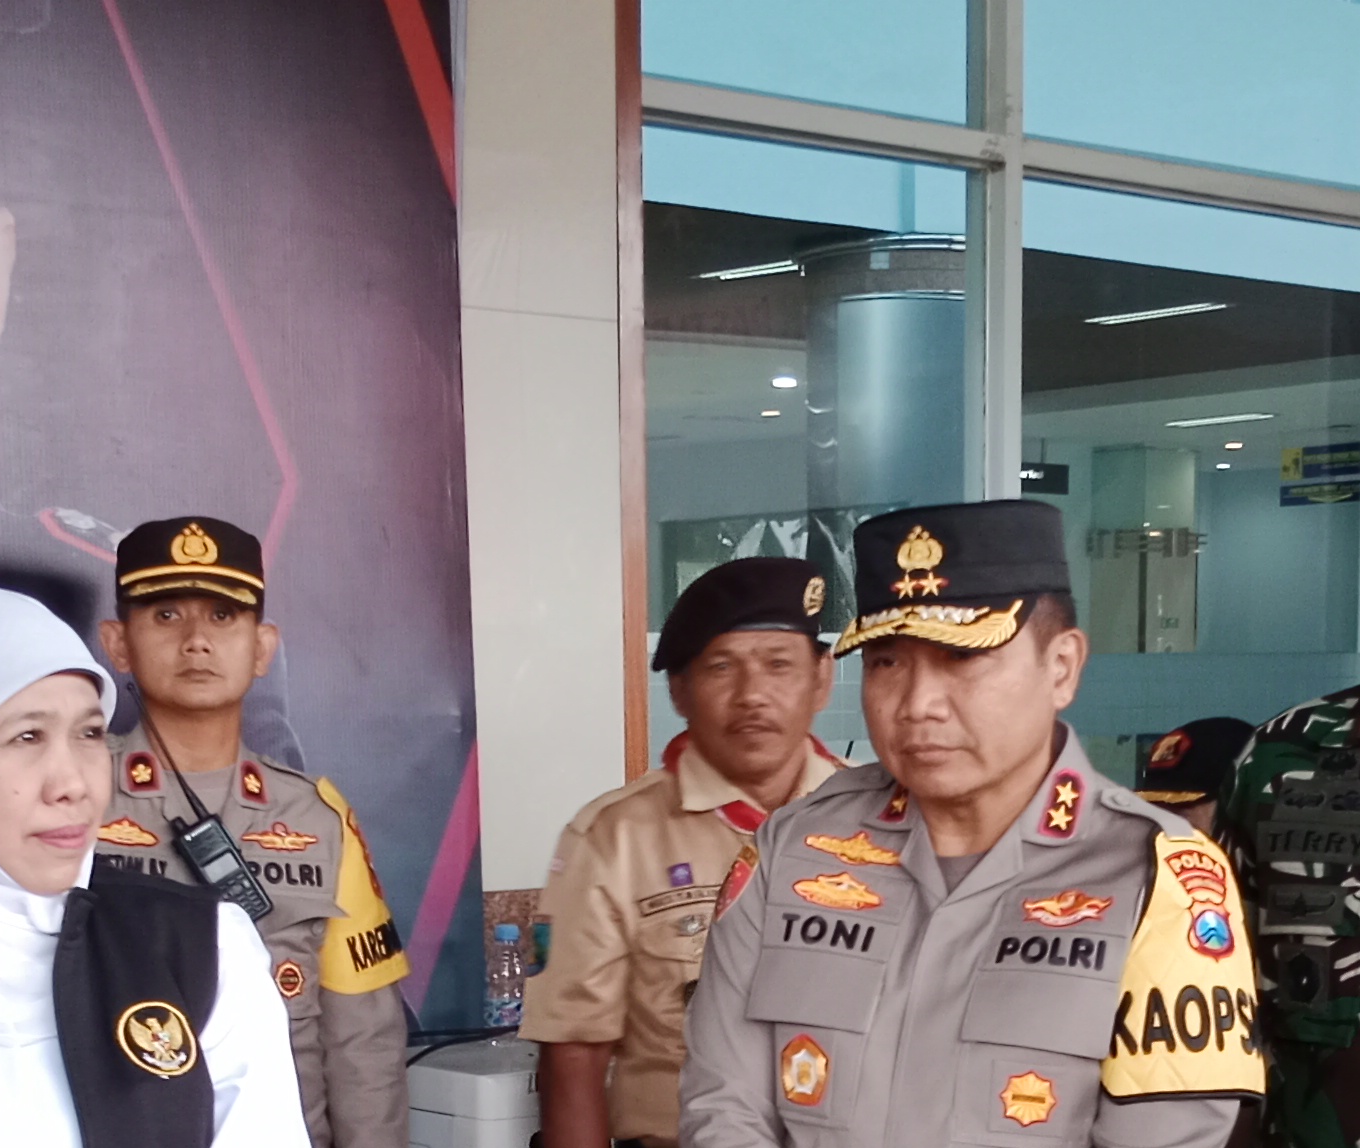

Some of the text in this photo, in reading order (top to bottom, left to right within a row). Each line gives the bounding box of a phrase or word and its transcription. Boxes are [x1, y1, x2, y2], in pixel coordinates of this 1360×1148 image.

[246, 860, 323, 888] POLRI
[782, 913, 875, 953] TONI
[995, 935, 1107, 971] POLRI
